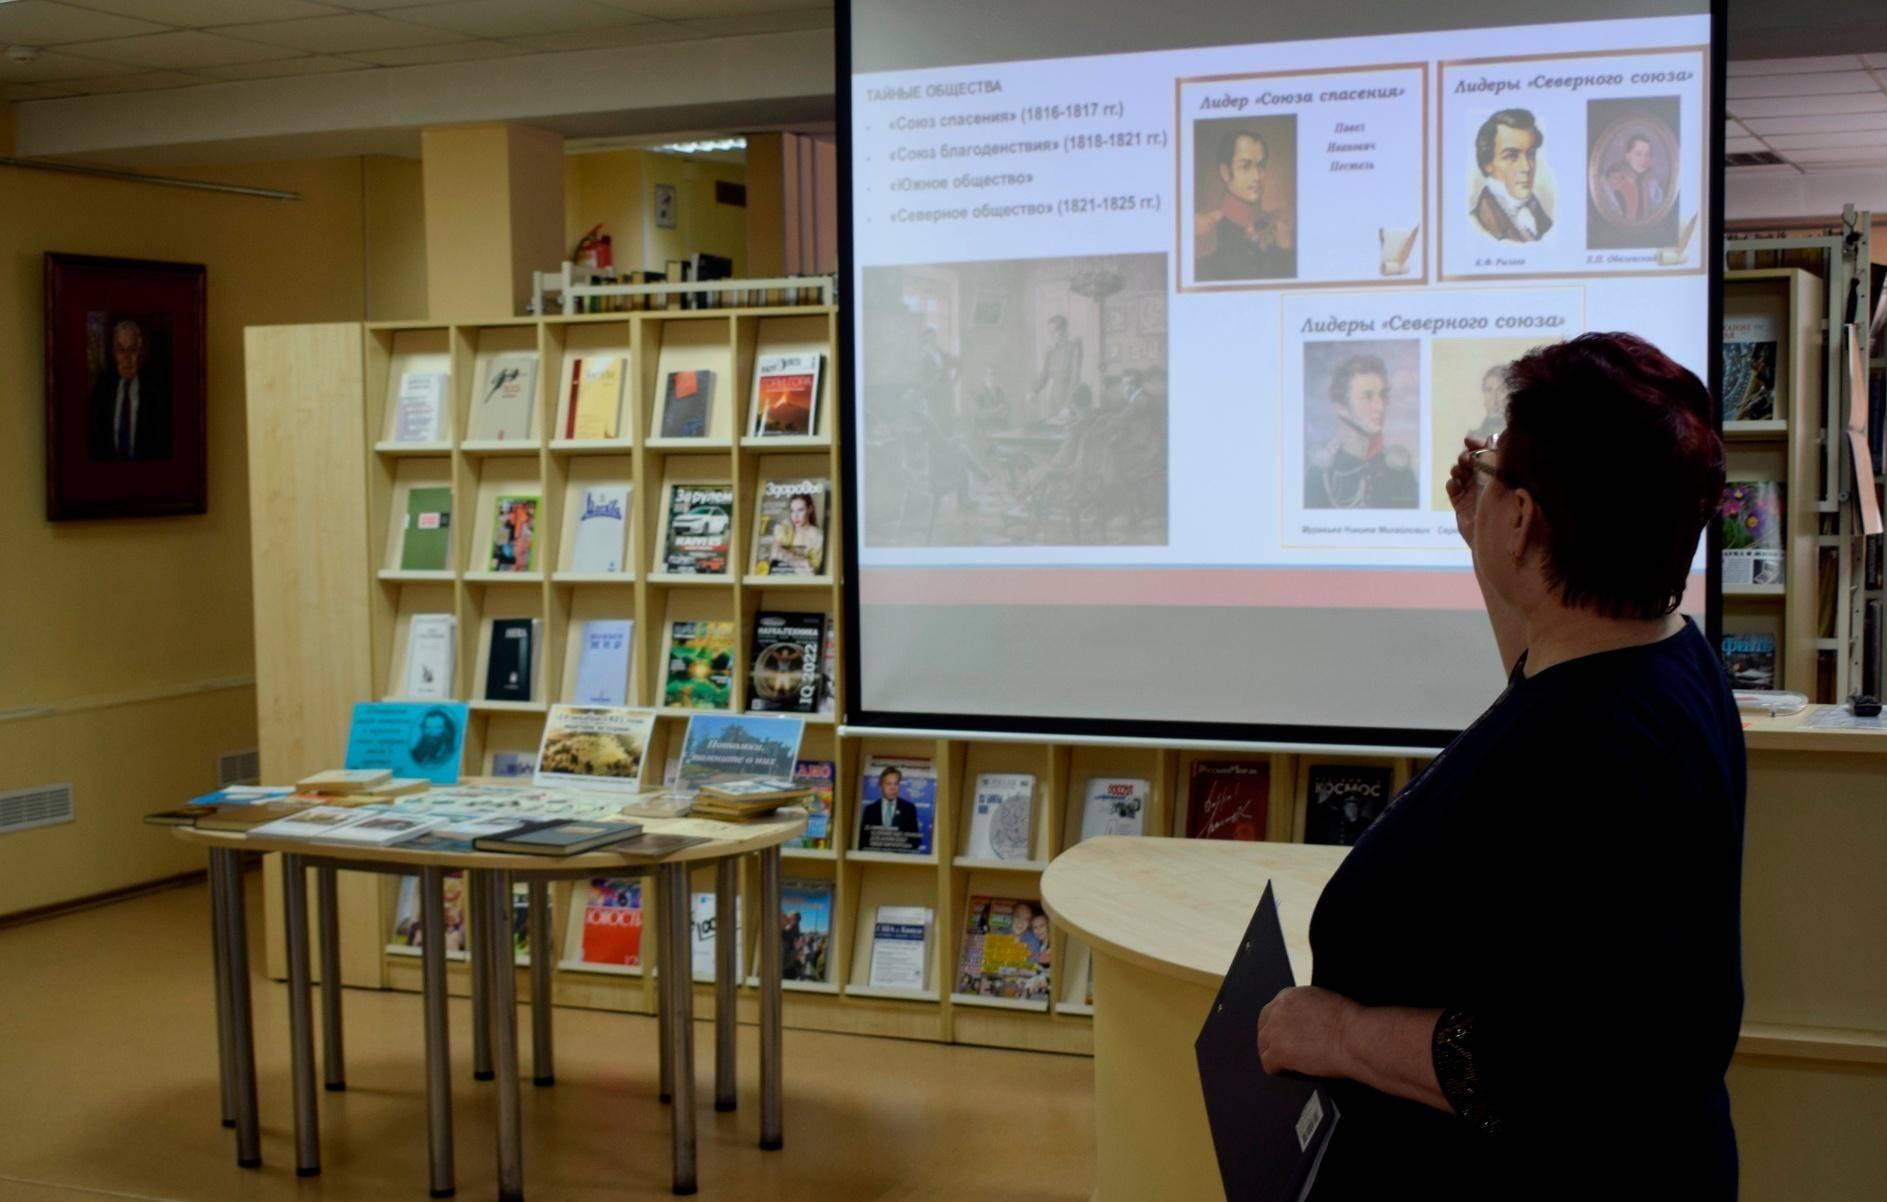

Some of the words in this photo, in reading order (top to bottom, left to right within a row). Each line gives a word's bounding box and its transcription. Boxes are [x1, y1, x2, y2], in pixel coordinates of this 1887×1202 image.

[866, 85, 922, 103] ТАЙНЫЕ
[926, 80, 1003, 100] ОБЩЕСТВА
[1454, 77, 1521, 95] Лидеры
[1528, 74, 1623, 90] «Северного
[1631, 70, 1694, 85] союза»
[1201, 91, 1249, 110] Лидер
[1255, 90, 1313, 106] «Союза
[1319, 86, 1405, 102] спасения»
[890, 115, 936, 131] «Союз
[940, 110, 1016, 128] спасения»
[1021, 103, 1098, 124] (1816-1817
[890, 146, 936, 162] «Союз
[940, 139, 1059, 159] благоденствия»
[1064, 133, 1142, 153] (1818-1821
[890, 177, 948, 192] «Южное
[953, 172, 1034, 190] общество»
[890, 207, 968, 224] «Северное
[972, 202, 1053, 220] общество»
[1057, 196, 1136, 216] (1821-1825
[1300, 315, 1375, 336] Лидеры
[1382, 315, 1489, 334] «Северного
[1495, 314, 1565, 329] союза»
[765, 480, 824, 498] Здоровье
[1314, 781, 1382, 798] КОСМОС
